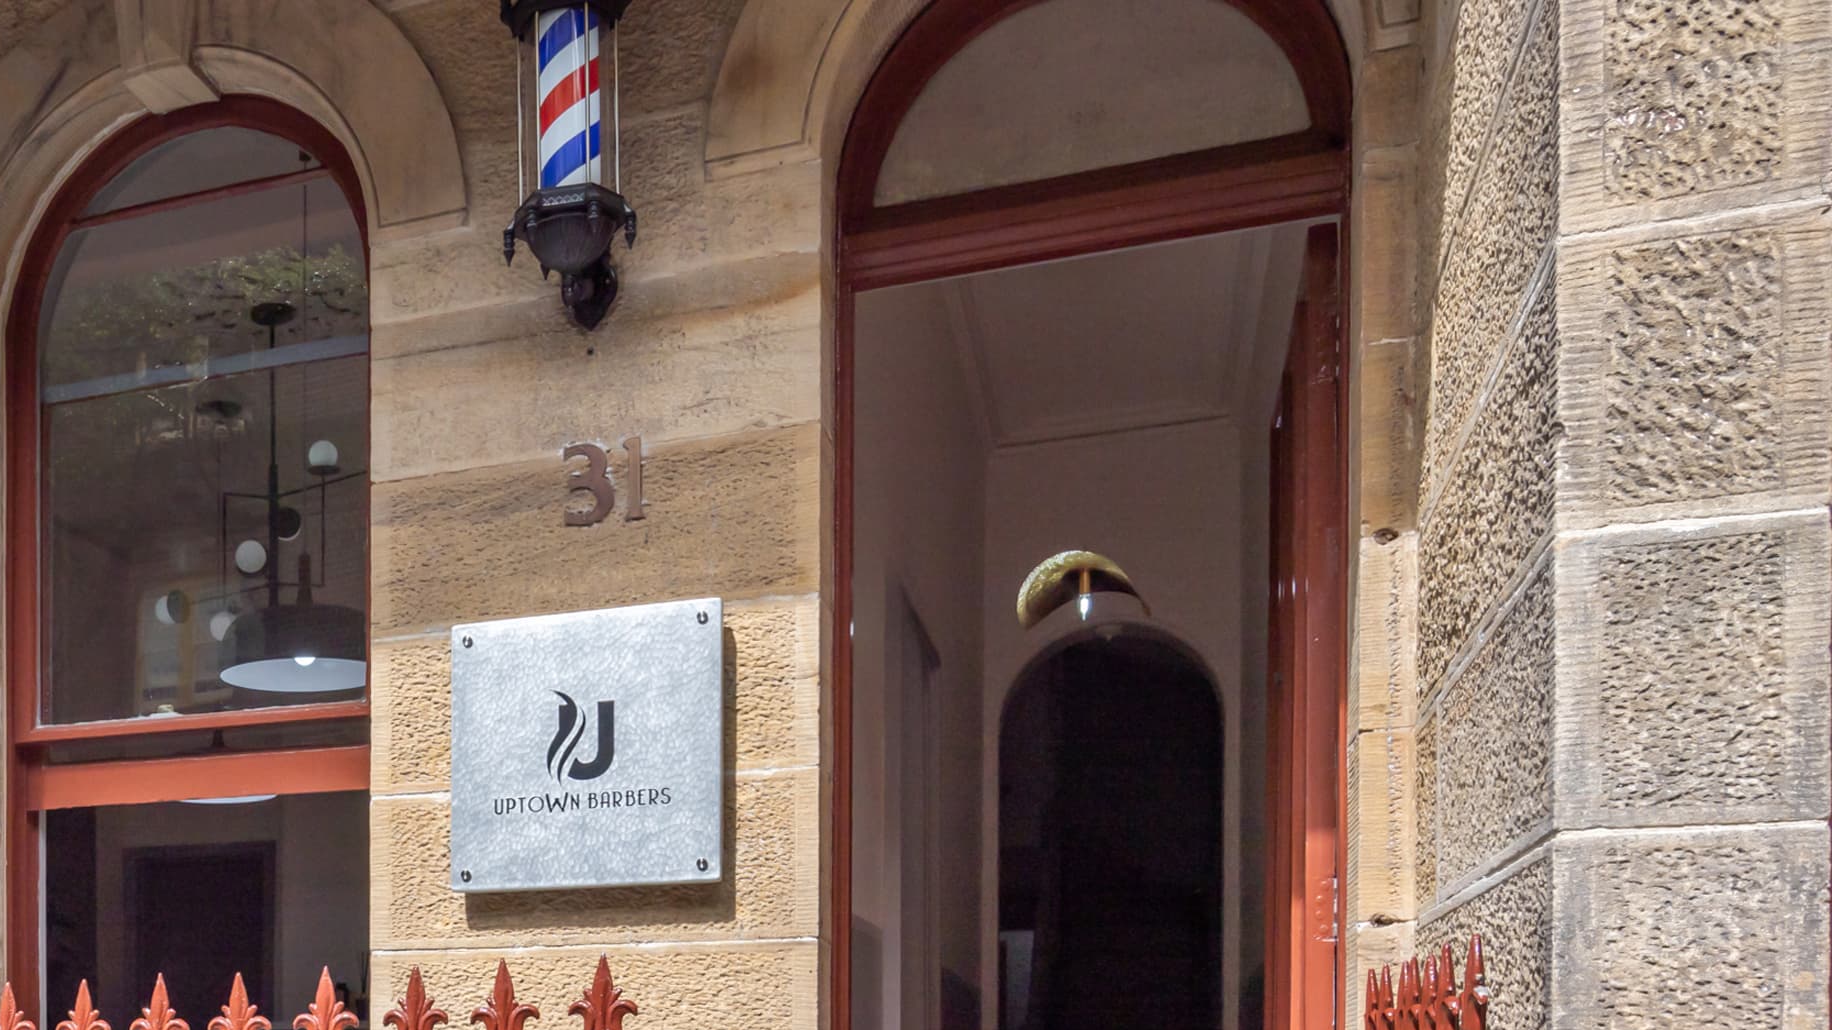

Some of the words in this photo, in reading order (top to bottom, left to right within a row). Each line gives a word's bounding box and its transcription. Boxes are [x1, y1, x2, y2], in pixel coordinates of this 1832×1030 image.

[563, 436, 646, 527] 31
[494, 792, 580, 815] UPTOWN
[588, 787, 672, 809] BARBERS
